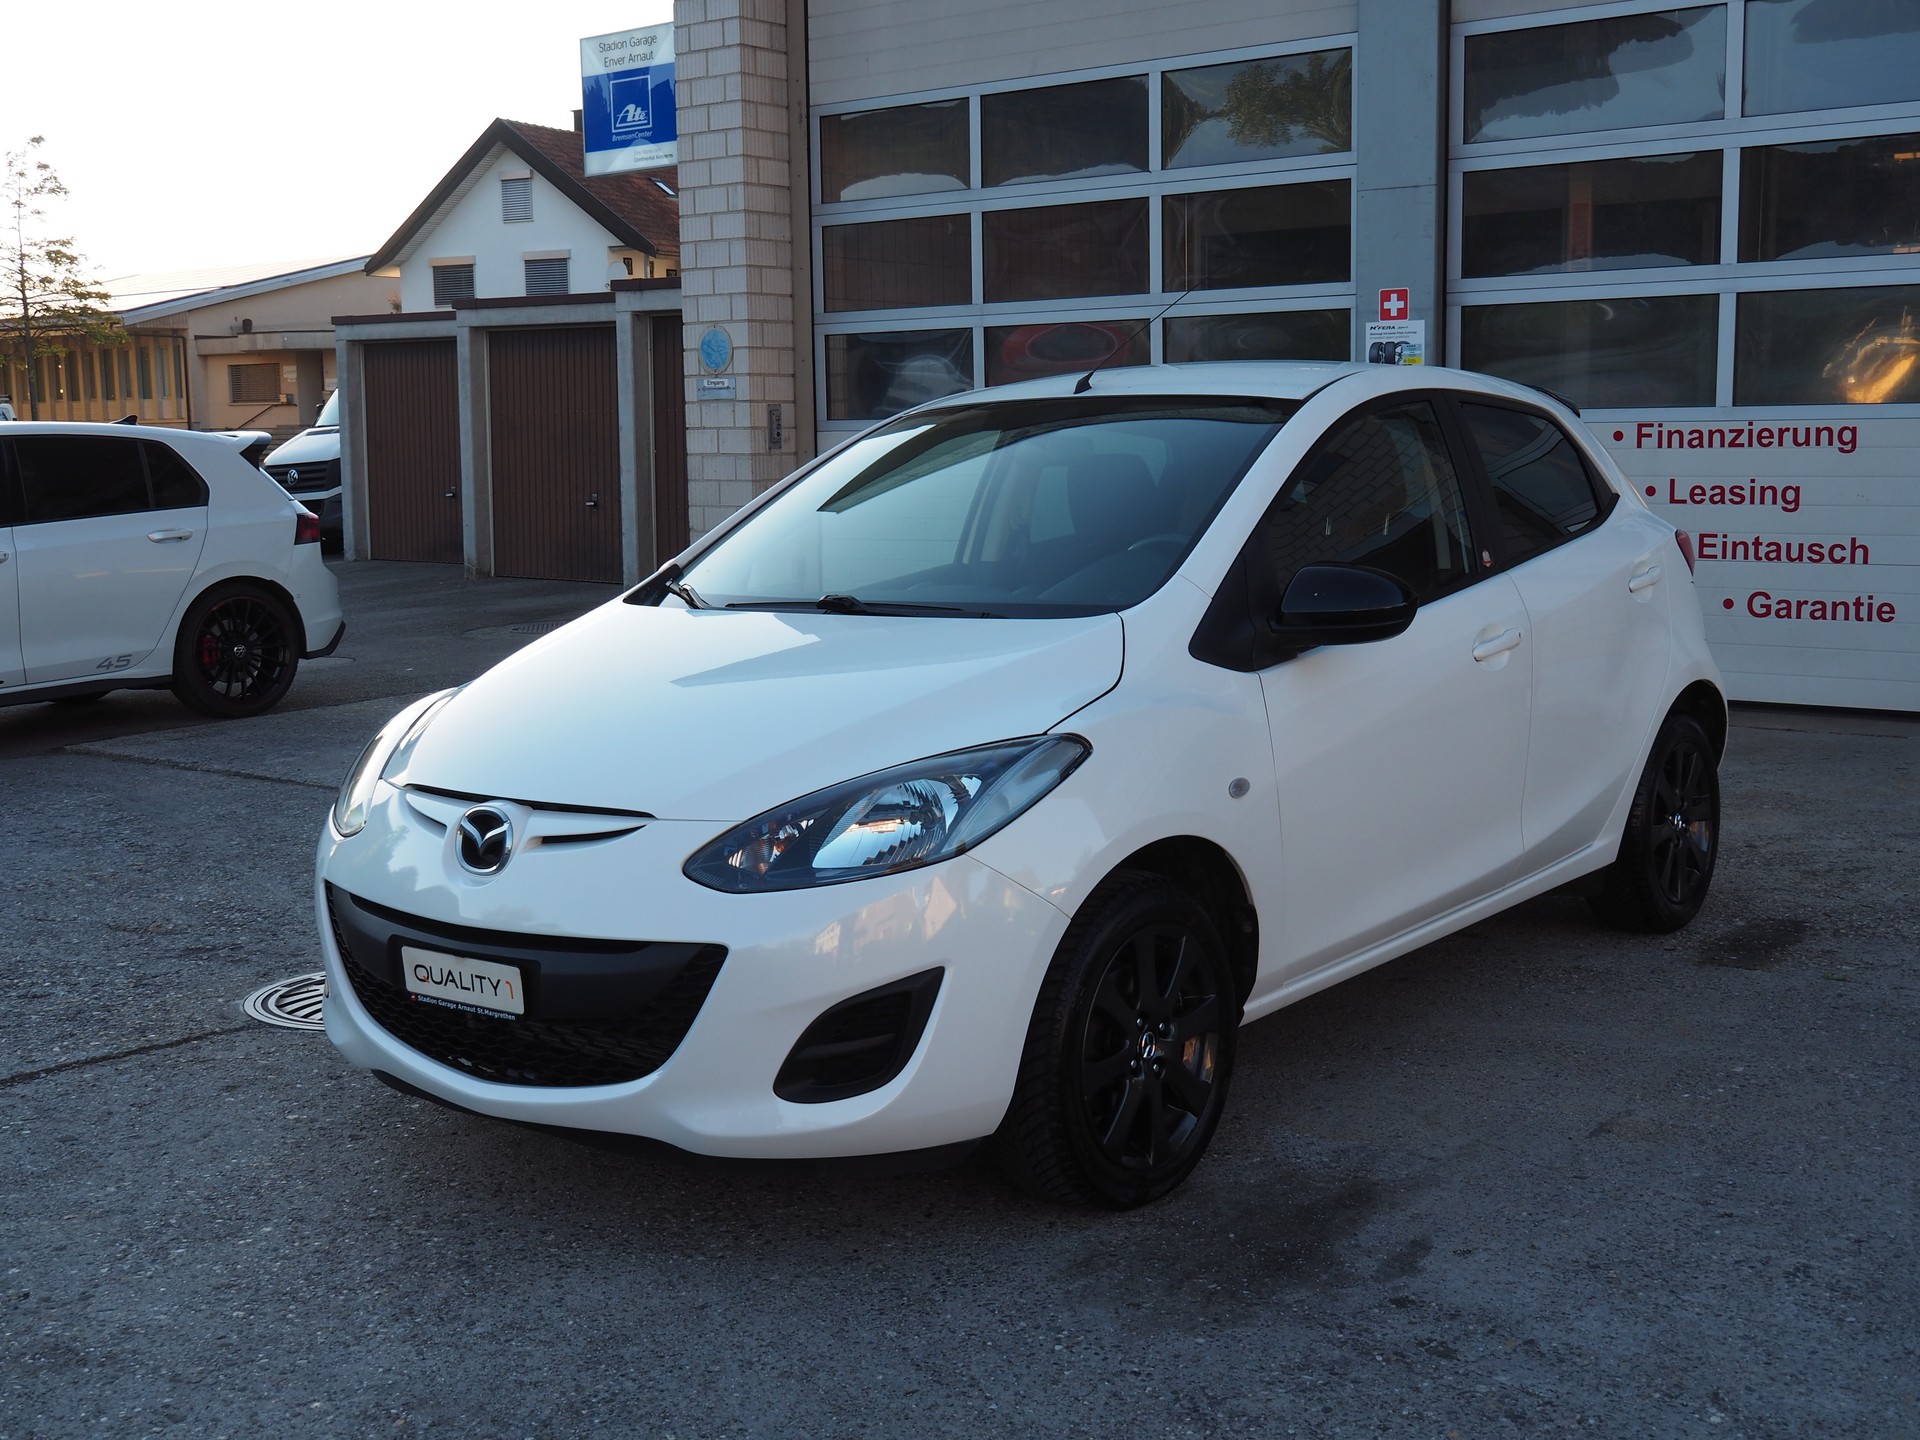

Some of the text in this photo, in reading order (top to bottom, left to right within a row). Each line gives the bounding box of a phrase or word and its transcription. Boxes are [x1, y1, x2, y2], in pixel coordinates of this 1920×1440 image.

[598, 35, 657, 53] Stadion Garage
[604, 50, 654, 67] Enver Arnaut
[1636, 421, 1858, 454] Finanzierung
[1669, 478, 1801, 513] Leasing
[1698, 533, 1869, 565] Eintausch
[1747, 591, 1896, 623] Garantie
[96, 654, 132, 670] 45
[414, 964, 501, 996] QUALITY
[418, 995, 438, 1005] Stadion
[438, 1000, 457, 1009] Garage
[458, 1003, 476, 1013] Arnaut
